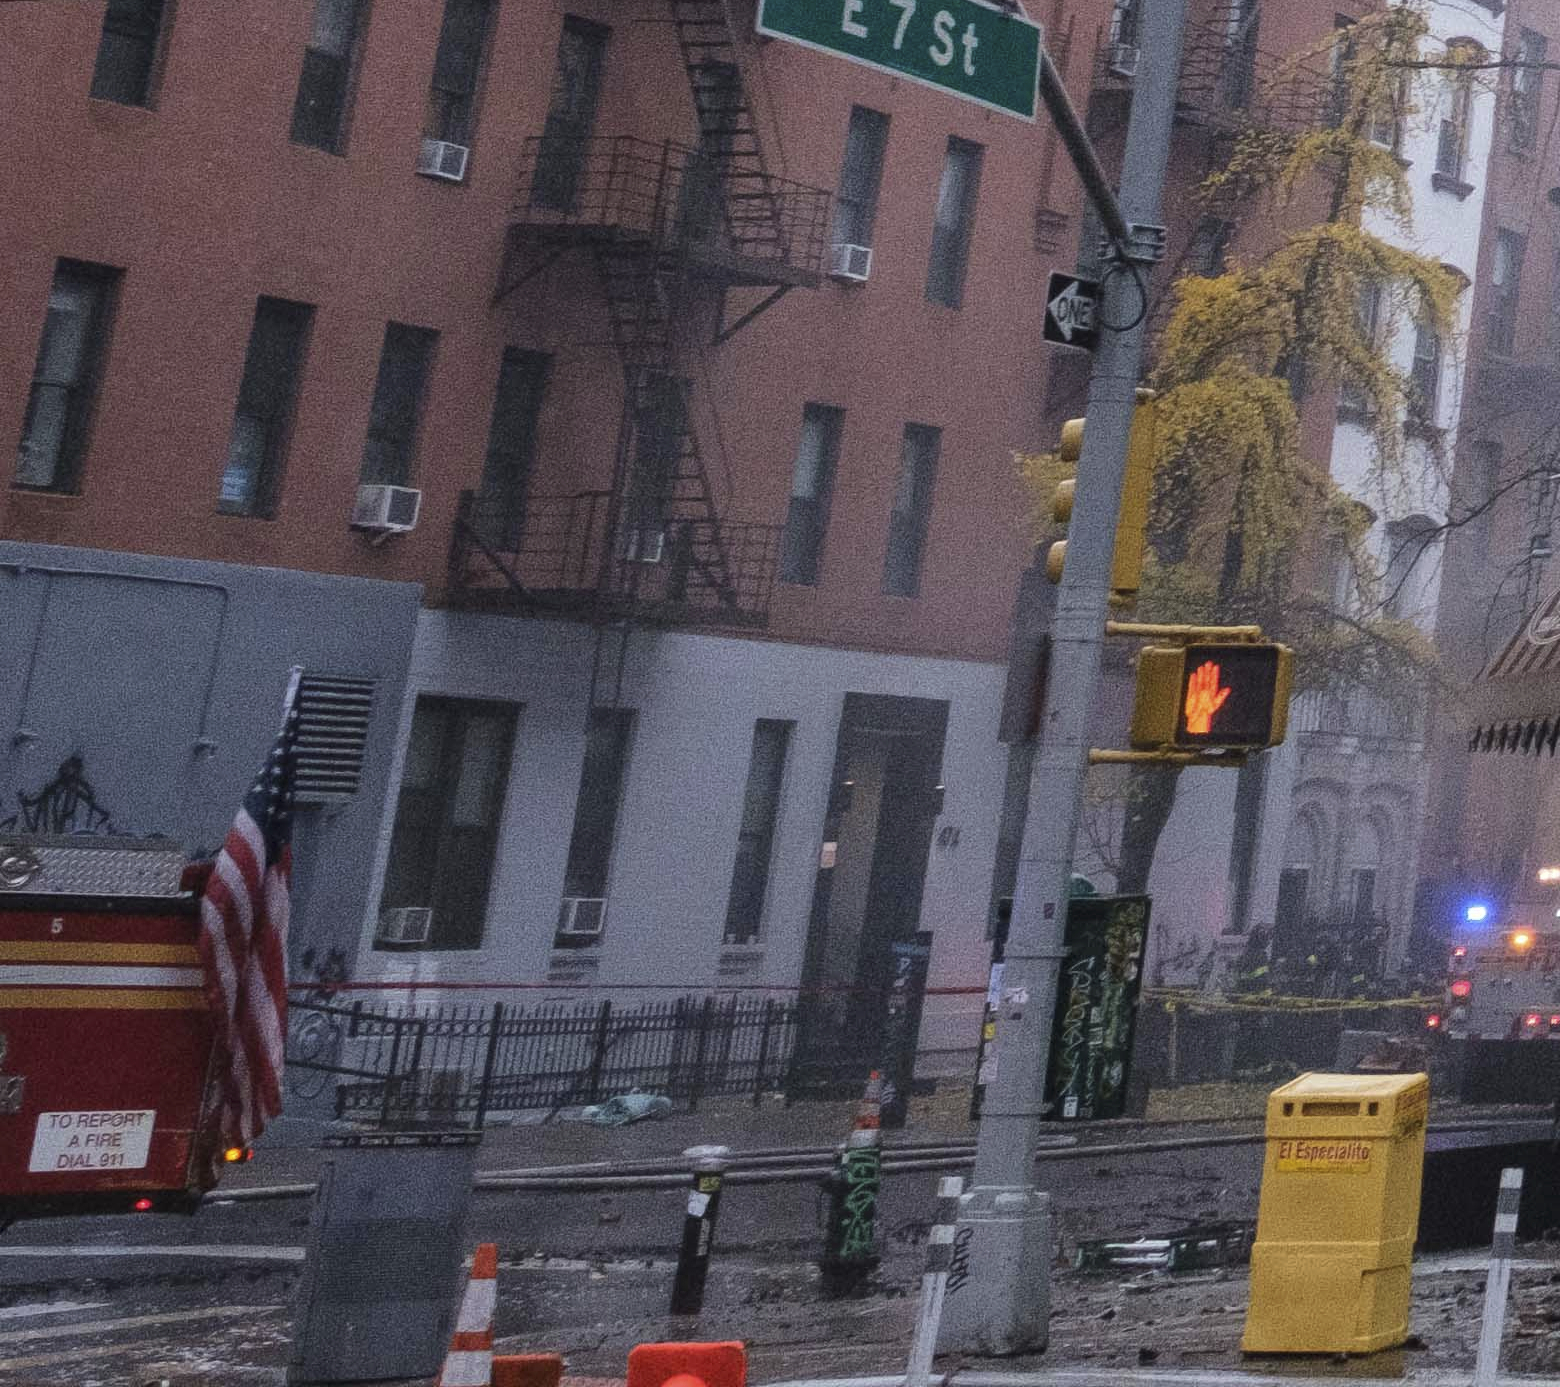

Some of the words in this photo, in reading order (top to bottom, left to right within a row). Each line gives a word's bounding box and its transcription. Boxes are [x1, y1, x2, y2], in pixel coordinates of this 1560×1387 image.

[928, 10, 979, 77] St
[1056, 296, 1092, 325] ONE
[51, 917, 64, 934] 5
[49, 1114, 72, 1129] TO
[77, 1112, 146, 1128] REPORT
[67, 1135, 79, 1148] A
[85, 1133, 123, 1148] FIRE
[1279, 1141, 1291, 1159] El
[1295, 1140, 1370, 1162] Especialito
[56, 1154, 94, 1169] DIAL
[99, 1153, 125, 1167] 911
